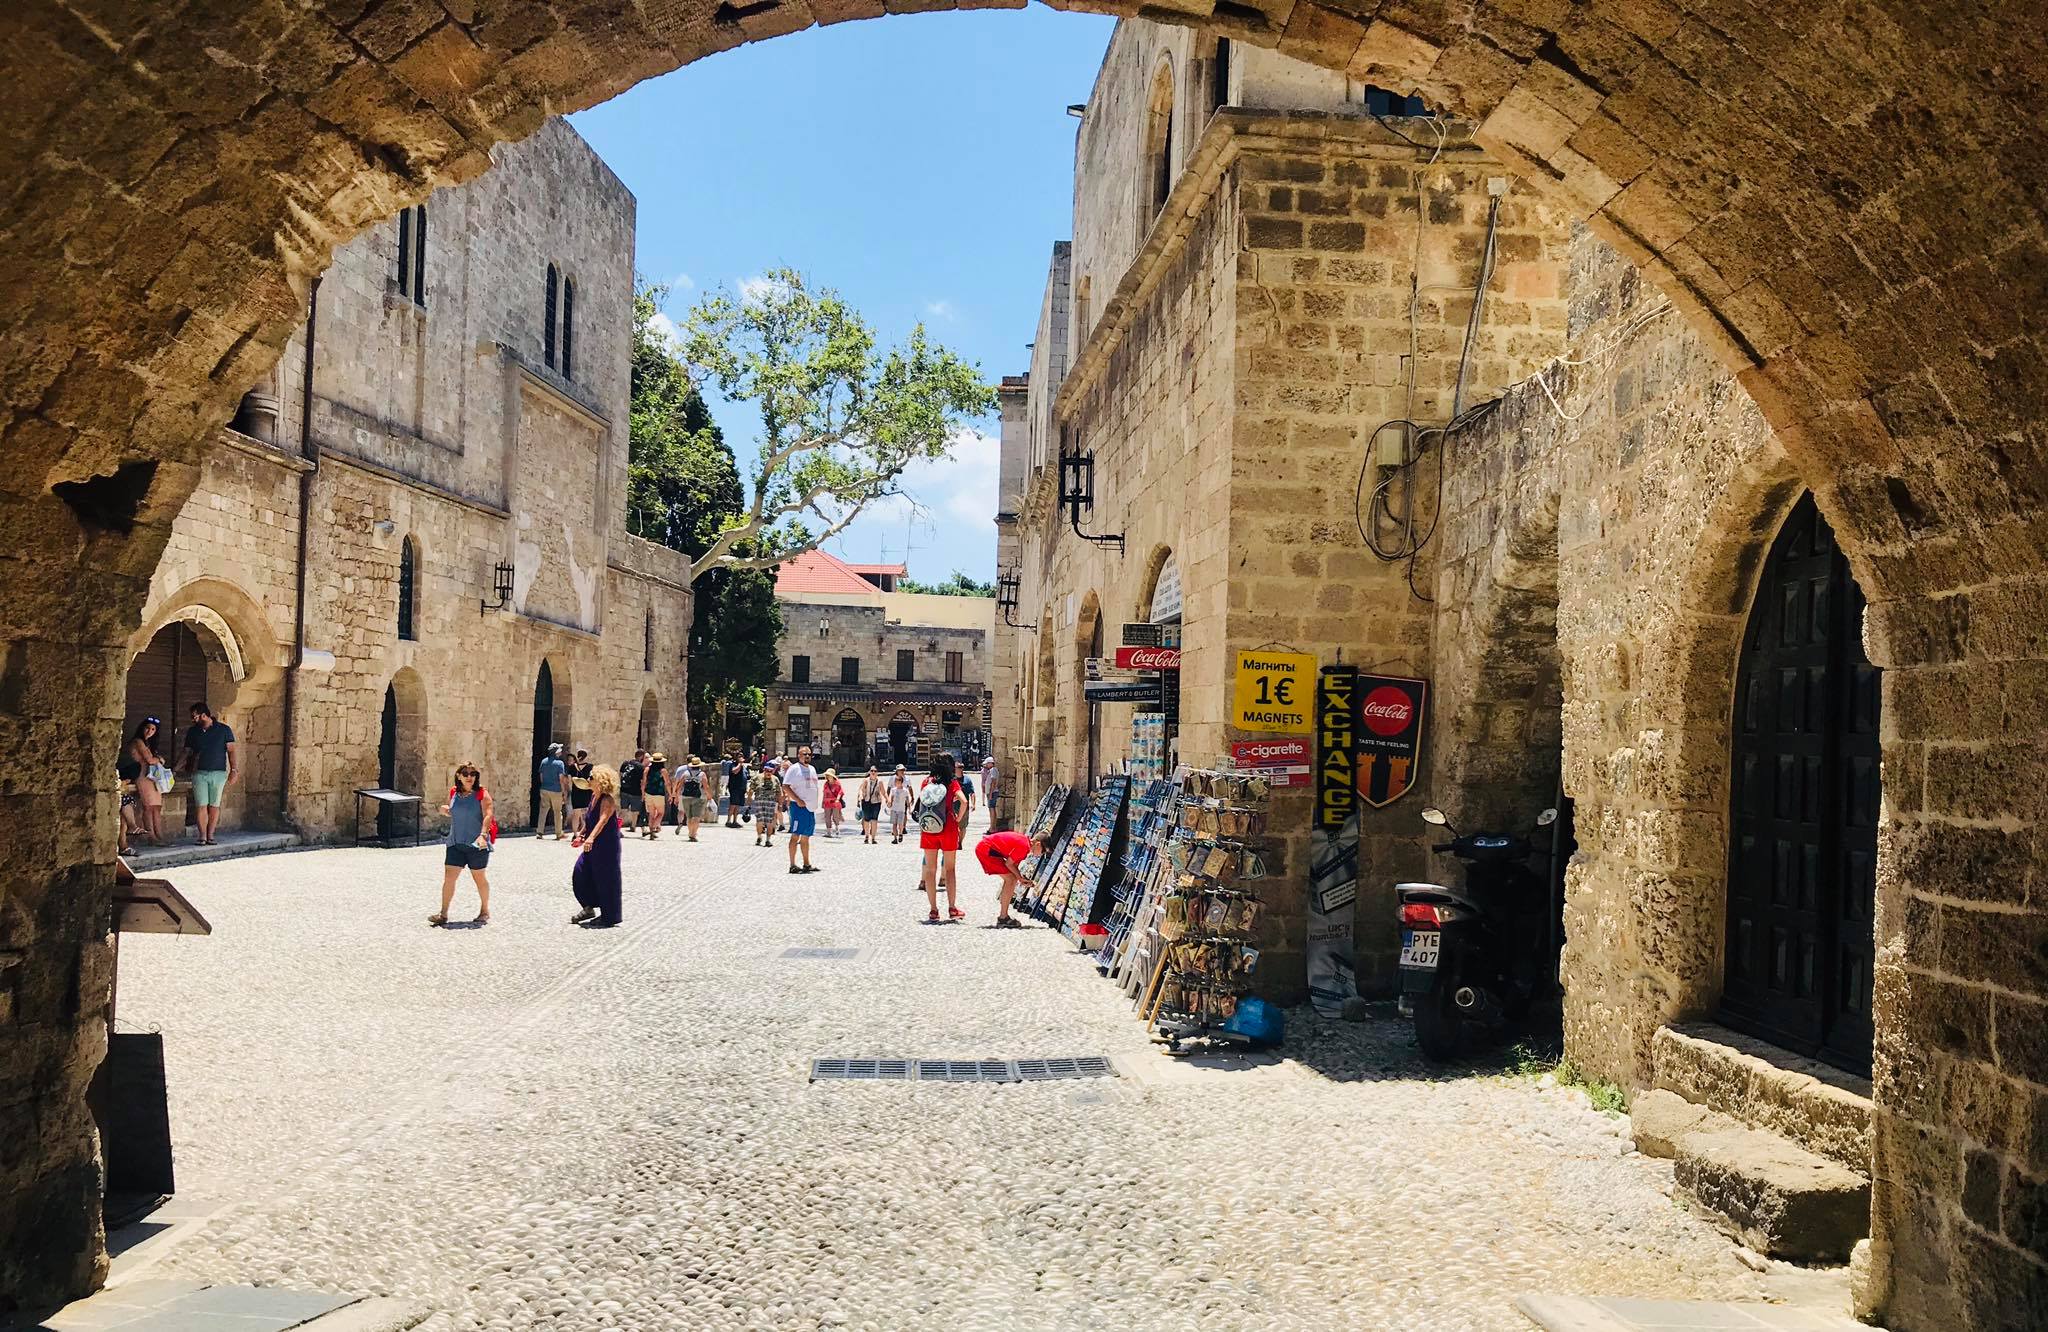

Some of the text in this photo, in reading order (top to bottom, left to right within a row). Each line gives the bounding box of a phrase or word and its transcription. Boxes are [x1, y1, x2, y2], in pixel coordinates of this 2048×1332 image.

[1130, 649, 1180, 667] Coca-Cola
[1243, 659, 1296, 672] Магниты
[1133, 689, 1160, 697] BUTLER
[1255, 676, 1295, 705] 1€
[1364, 701, 1411, 719] Coca-Cola
[1243, 711, 1303, 724] MAGNETS
[1237, 743, 1303, 758] e-cigarette
[1323, 674, 1352, 824] EXCHANGE
[1387, 741, 1409, 749] FEELING
[1412, 934, 1439, 947] PYE
[1410, 951, 1438, 963] 407
